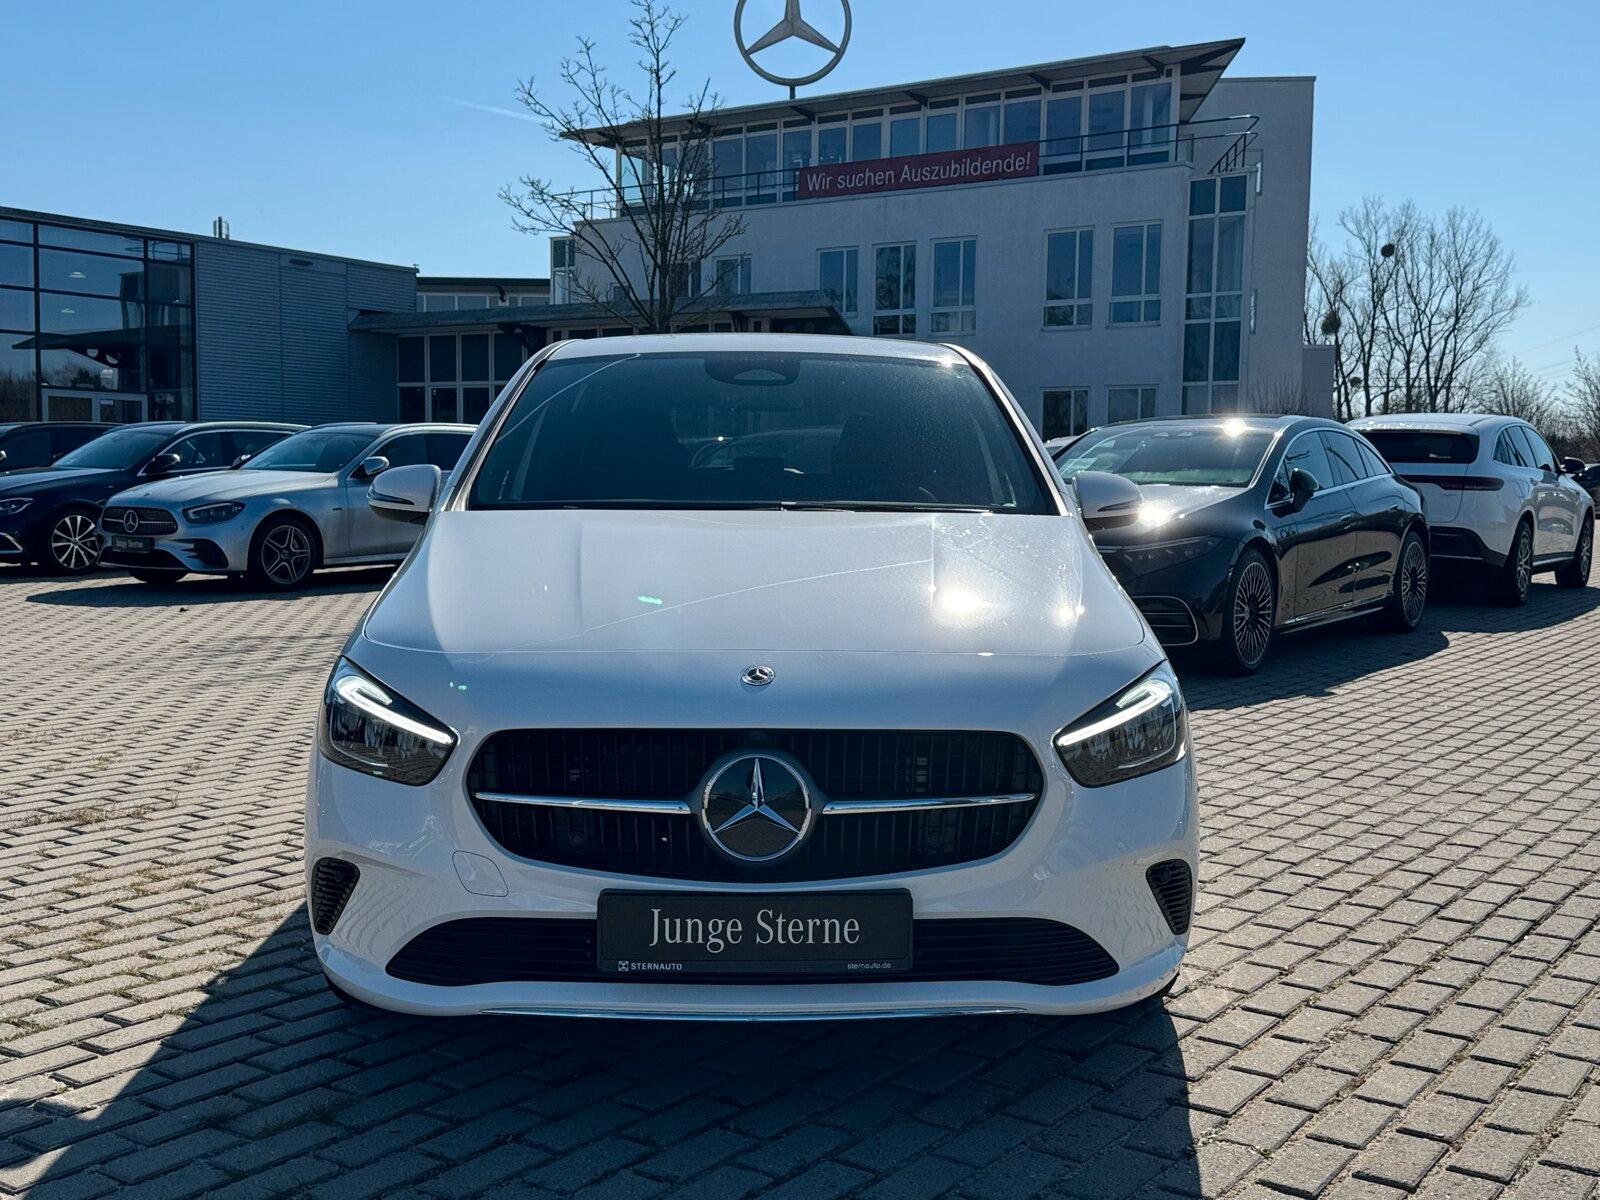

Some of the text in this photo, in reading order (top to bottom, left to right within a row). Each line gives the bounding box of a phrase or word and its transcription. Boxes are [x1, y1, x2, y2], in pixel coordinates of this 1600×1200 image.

[807, 152, 1031, 192] Wir suchen Auszubildende!
[649, 908, 860, 953] Junge Sterne
[630, 962, 683, 971] STERNAUTO
